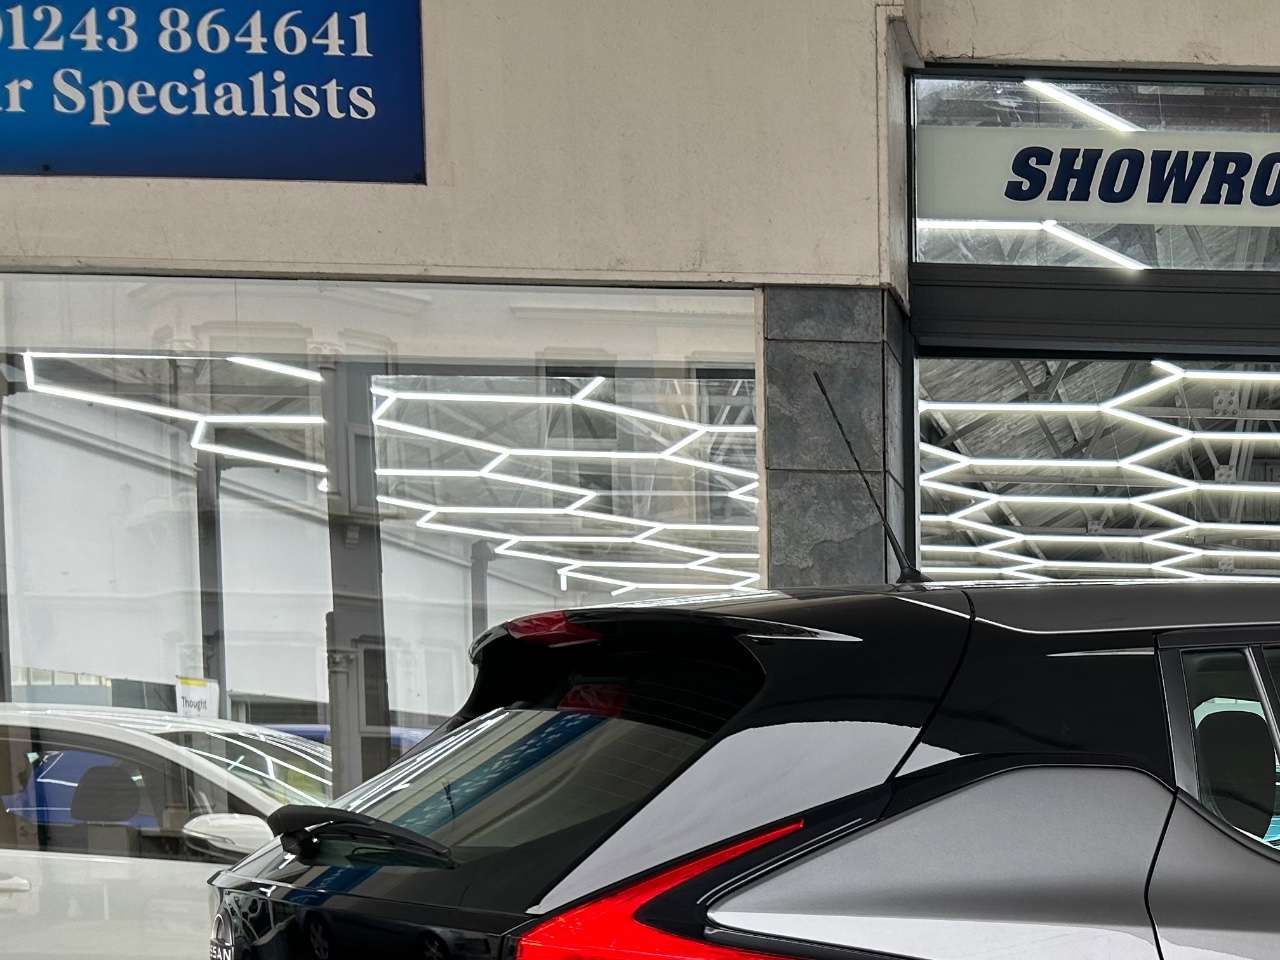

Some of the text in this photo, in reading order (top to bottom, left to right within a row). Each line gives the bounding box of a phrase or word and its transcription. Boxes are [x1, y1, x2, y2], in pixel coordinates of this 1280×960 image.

[0, 4, 374, 57] 1243 864641
[0, 68, 377, 126] r Specialists
